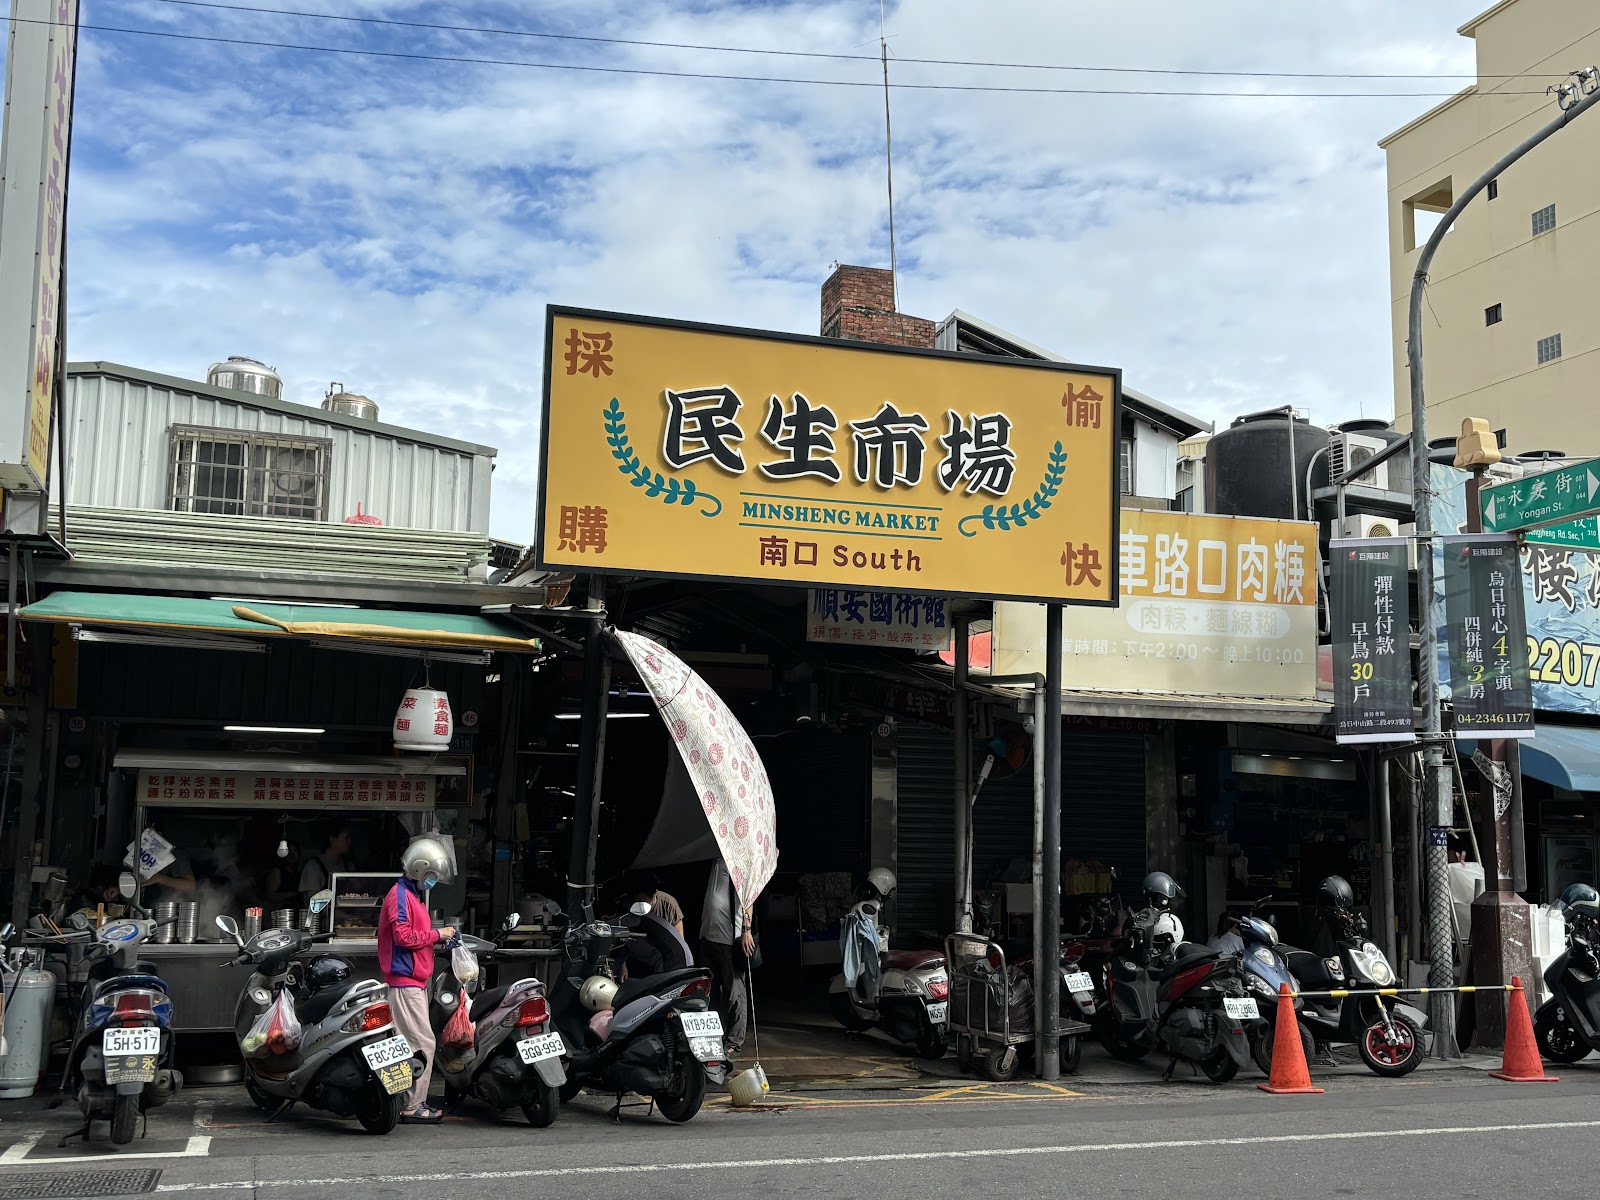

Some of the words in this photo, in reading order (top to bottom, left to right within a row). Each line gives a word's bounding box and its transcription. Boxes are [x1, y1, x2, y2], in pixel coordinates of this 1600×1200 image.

[564, 328, 613, 378] 採
[1062, 382, 1104, 430] 愉
[662, 384, 1017, 496] 民生市場
[1508, 472, 1573, 507] 永安街
[557, 504, 609, 554] 購
[742, 501, 852, 526] MINSHENG
[855, 509, 940, 532] MARKET
[1519, 505, 1551, 520] Yongan
[1552, 502, 1564, 511] St.
[759, 535, 819, 568] 南口
[832, 544, 922, 572] South
[1558, 530, 1567, 538] Rd.
[1060, 541, 1102, 588] 快
[813, 589, 947, 628] 順安國術館
[1374, 575, 1396, 656] 彈性付款
[1350, 622, 1374, 704] 早鳥30戶
[1464, 616, 1486, 700] 四併純3房
[433, 698, 450, 736] 素食麵
[464, 714, 476, 723] 46
[454, 740, 470, 748] 316
